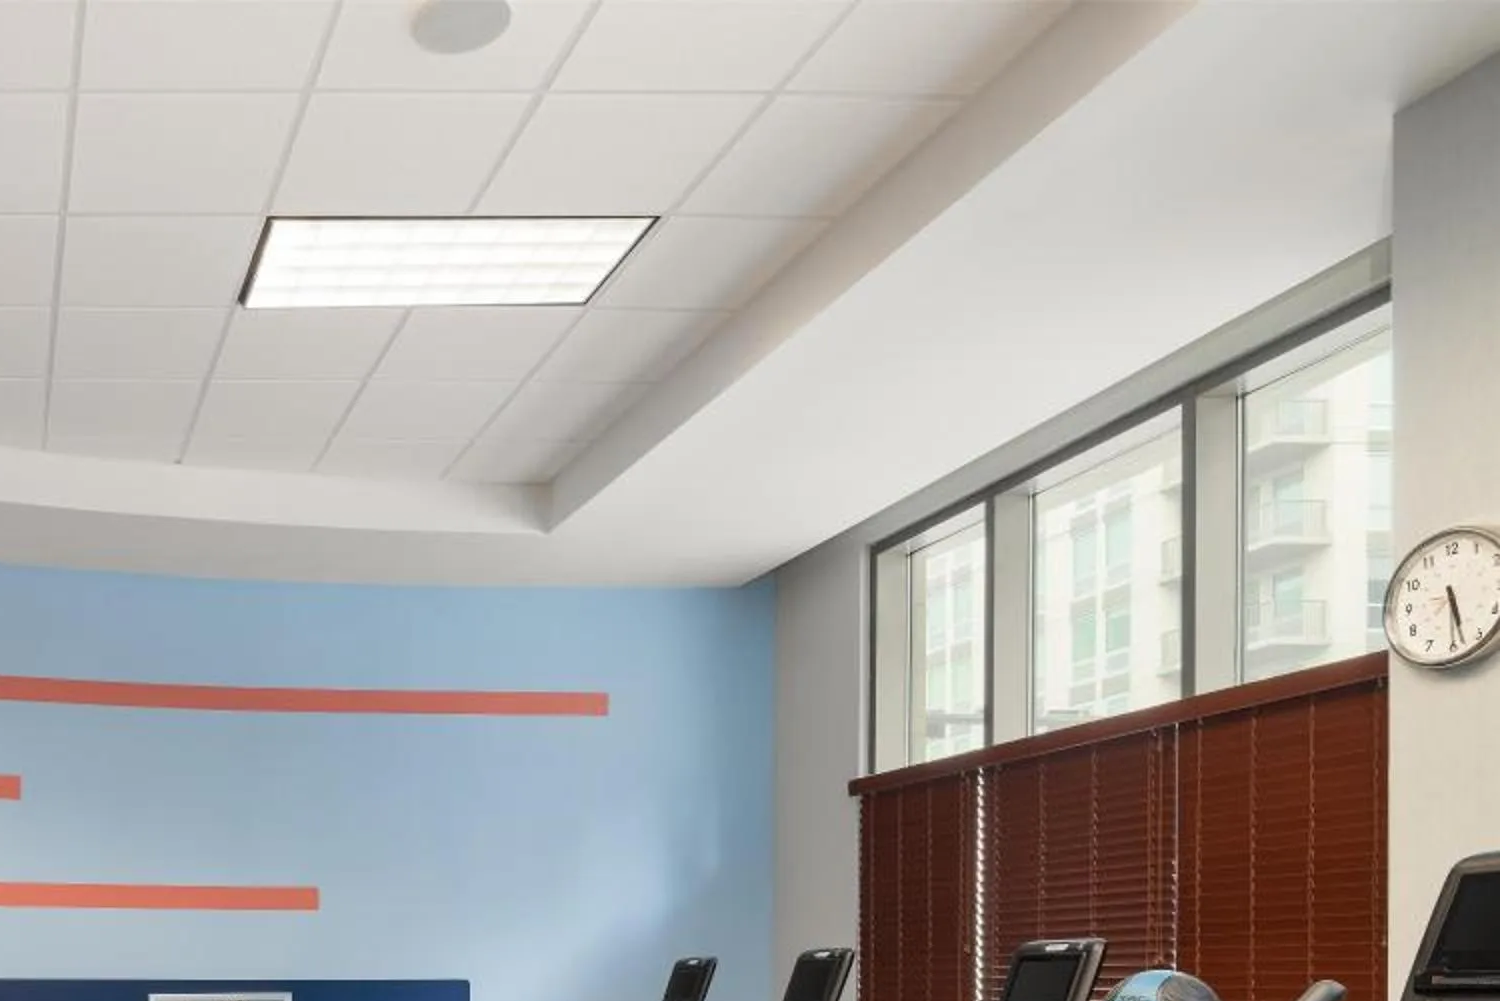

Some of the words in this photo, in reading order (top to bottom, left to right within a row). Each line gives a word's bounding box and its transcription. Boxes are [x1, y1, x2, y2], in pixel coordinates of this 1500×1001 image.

[1445, 541, 1459, 556] 12
[1423, 556, 1435, 570] 11
[1406, 578, 1421, 592] 10
[1405, 603, 1413, 616] 9
[1409, 623, 1417, 637] 8
[1424, 639, 1434, 652] 7
